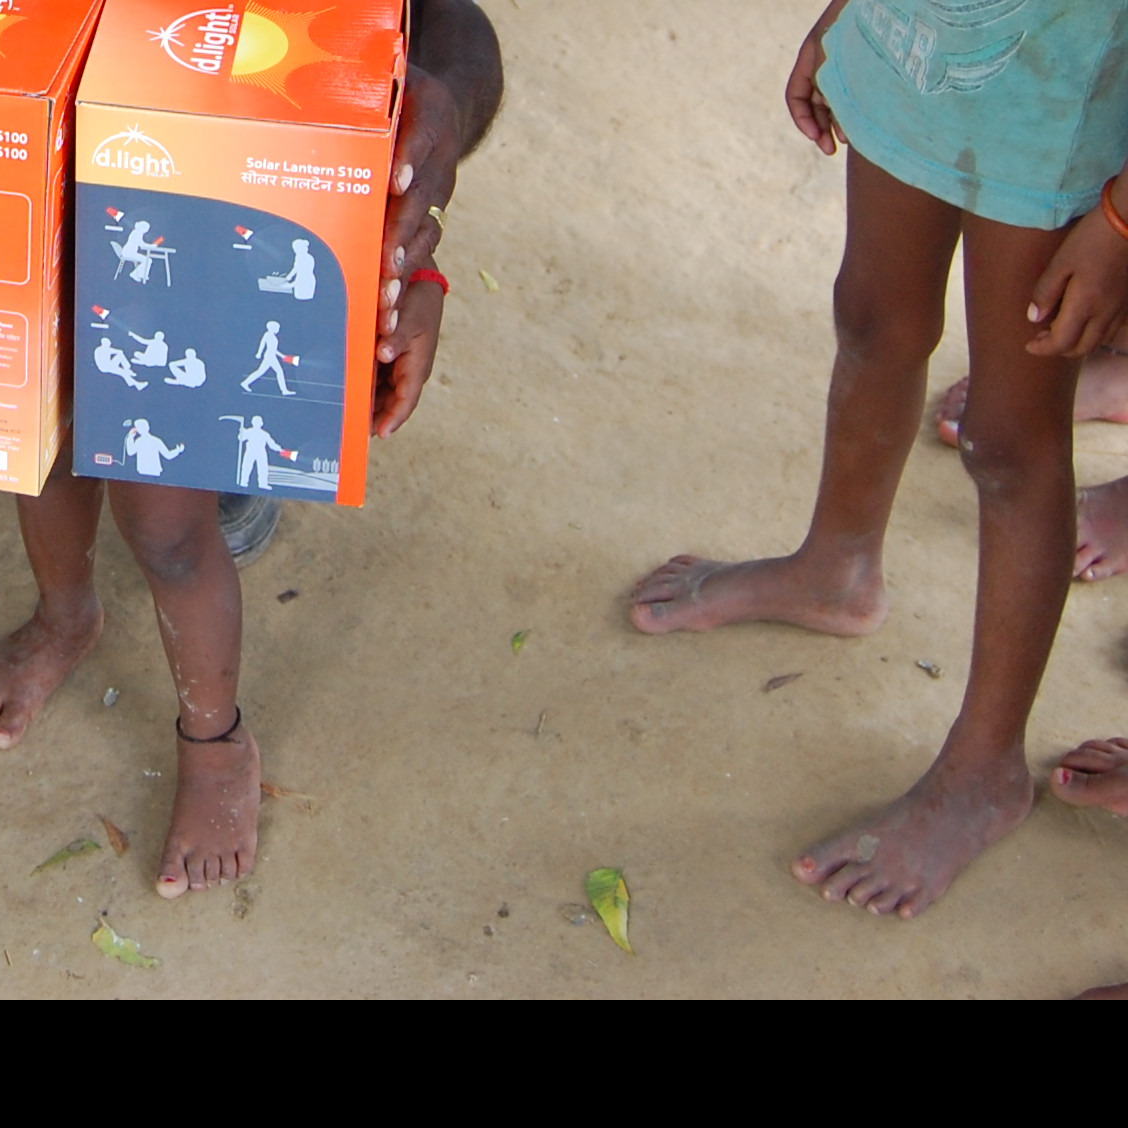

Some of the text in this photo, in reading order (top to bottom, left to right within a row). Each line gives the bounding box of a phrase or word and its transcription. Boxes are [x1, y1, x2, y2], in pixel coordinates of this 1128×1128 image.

[190, 13, 234, 71] d.light
[95, 148, 170, 175] d.light
[246, 157, 372, 180] Solar Lantern S100
[241, 170, 370, 195] सोलर लालटेन S100
